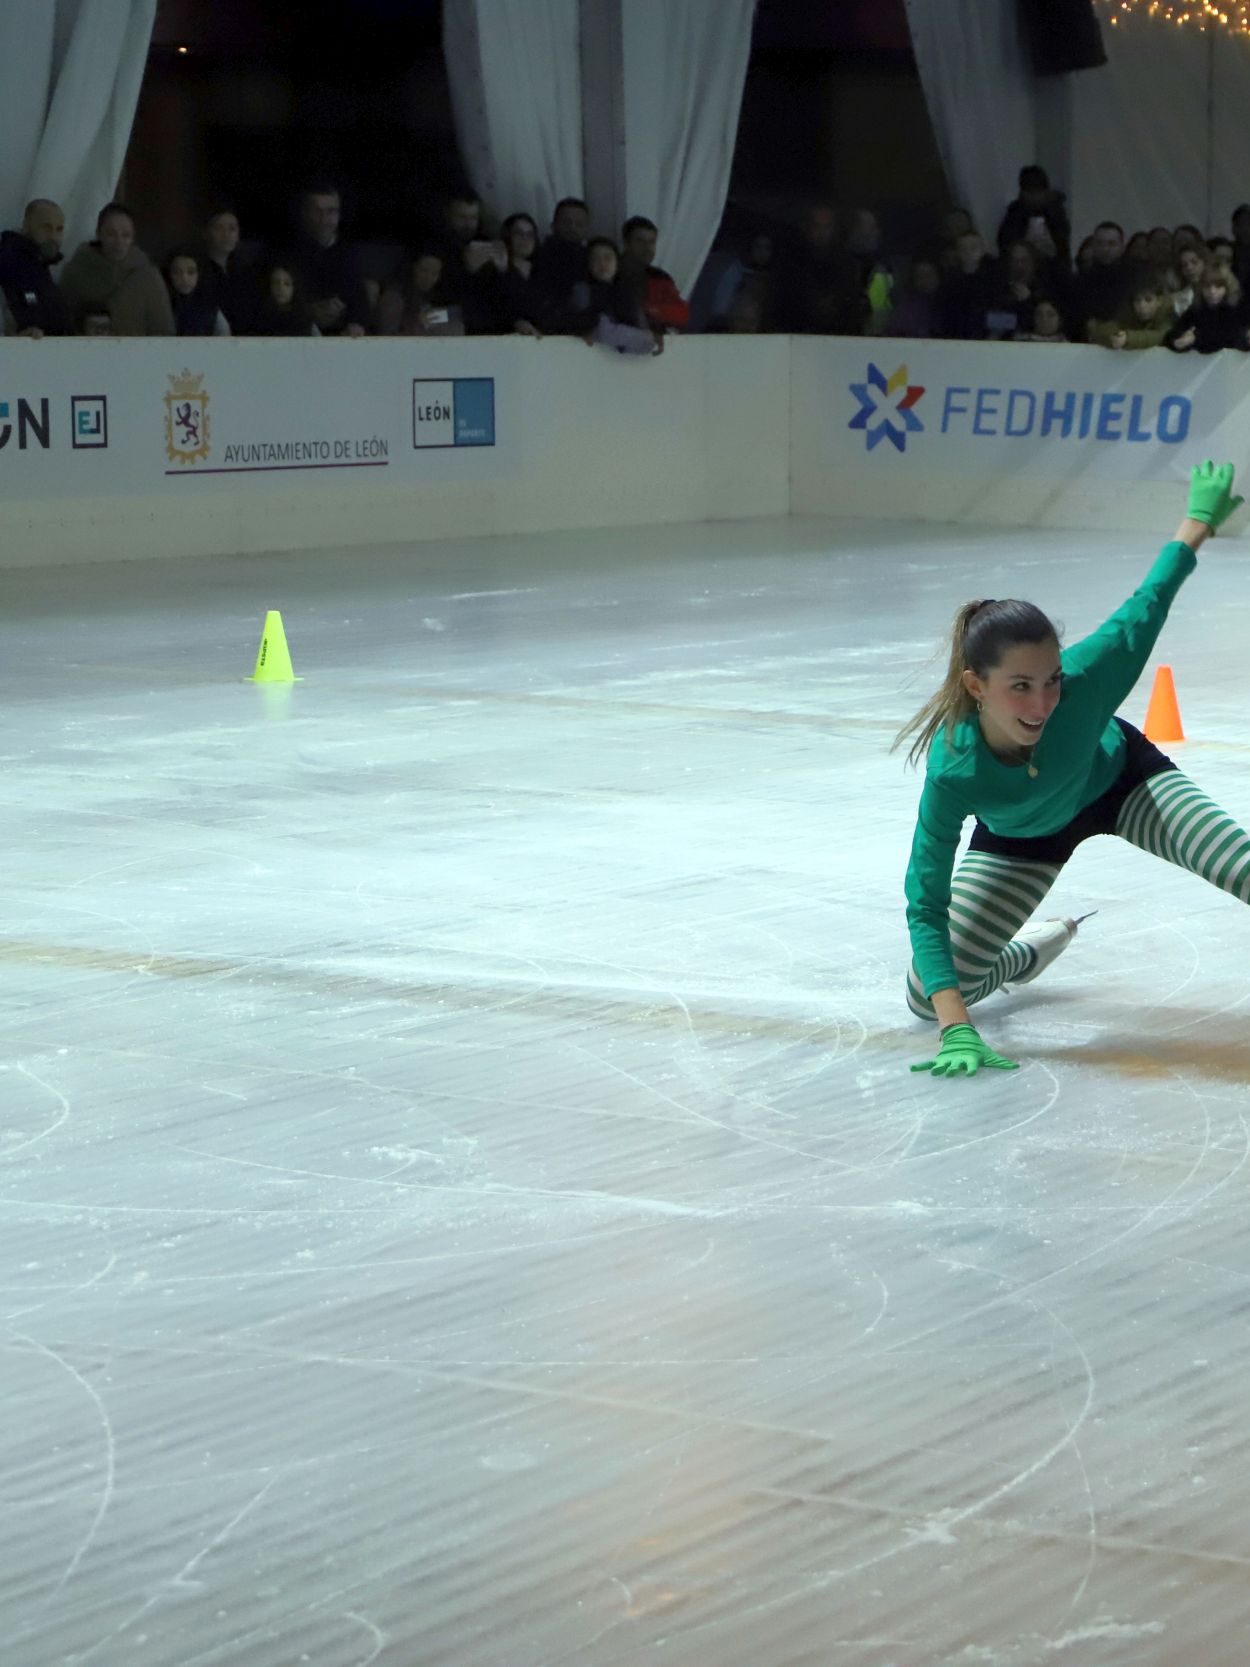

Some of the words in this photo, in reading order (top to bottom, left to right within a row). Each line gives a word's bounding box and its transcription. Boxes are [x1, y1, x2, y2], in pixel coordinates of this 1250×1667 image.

[418, 400, 451, 421] LEÓN
[941, 387, 1193, 444] FEDHIELO
[224, 441, 330, 462] AYUNTAMIENTO
[334, 440, 351, 458] DE
[356, 434, 389, 457] LEÓN
